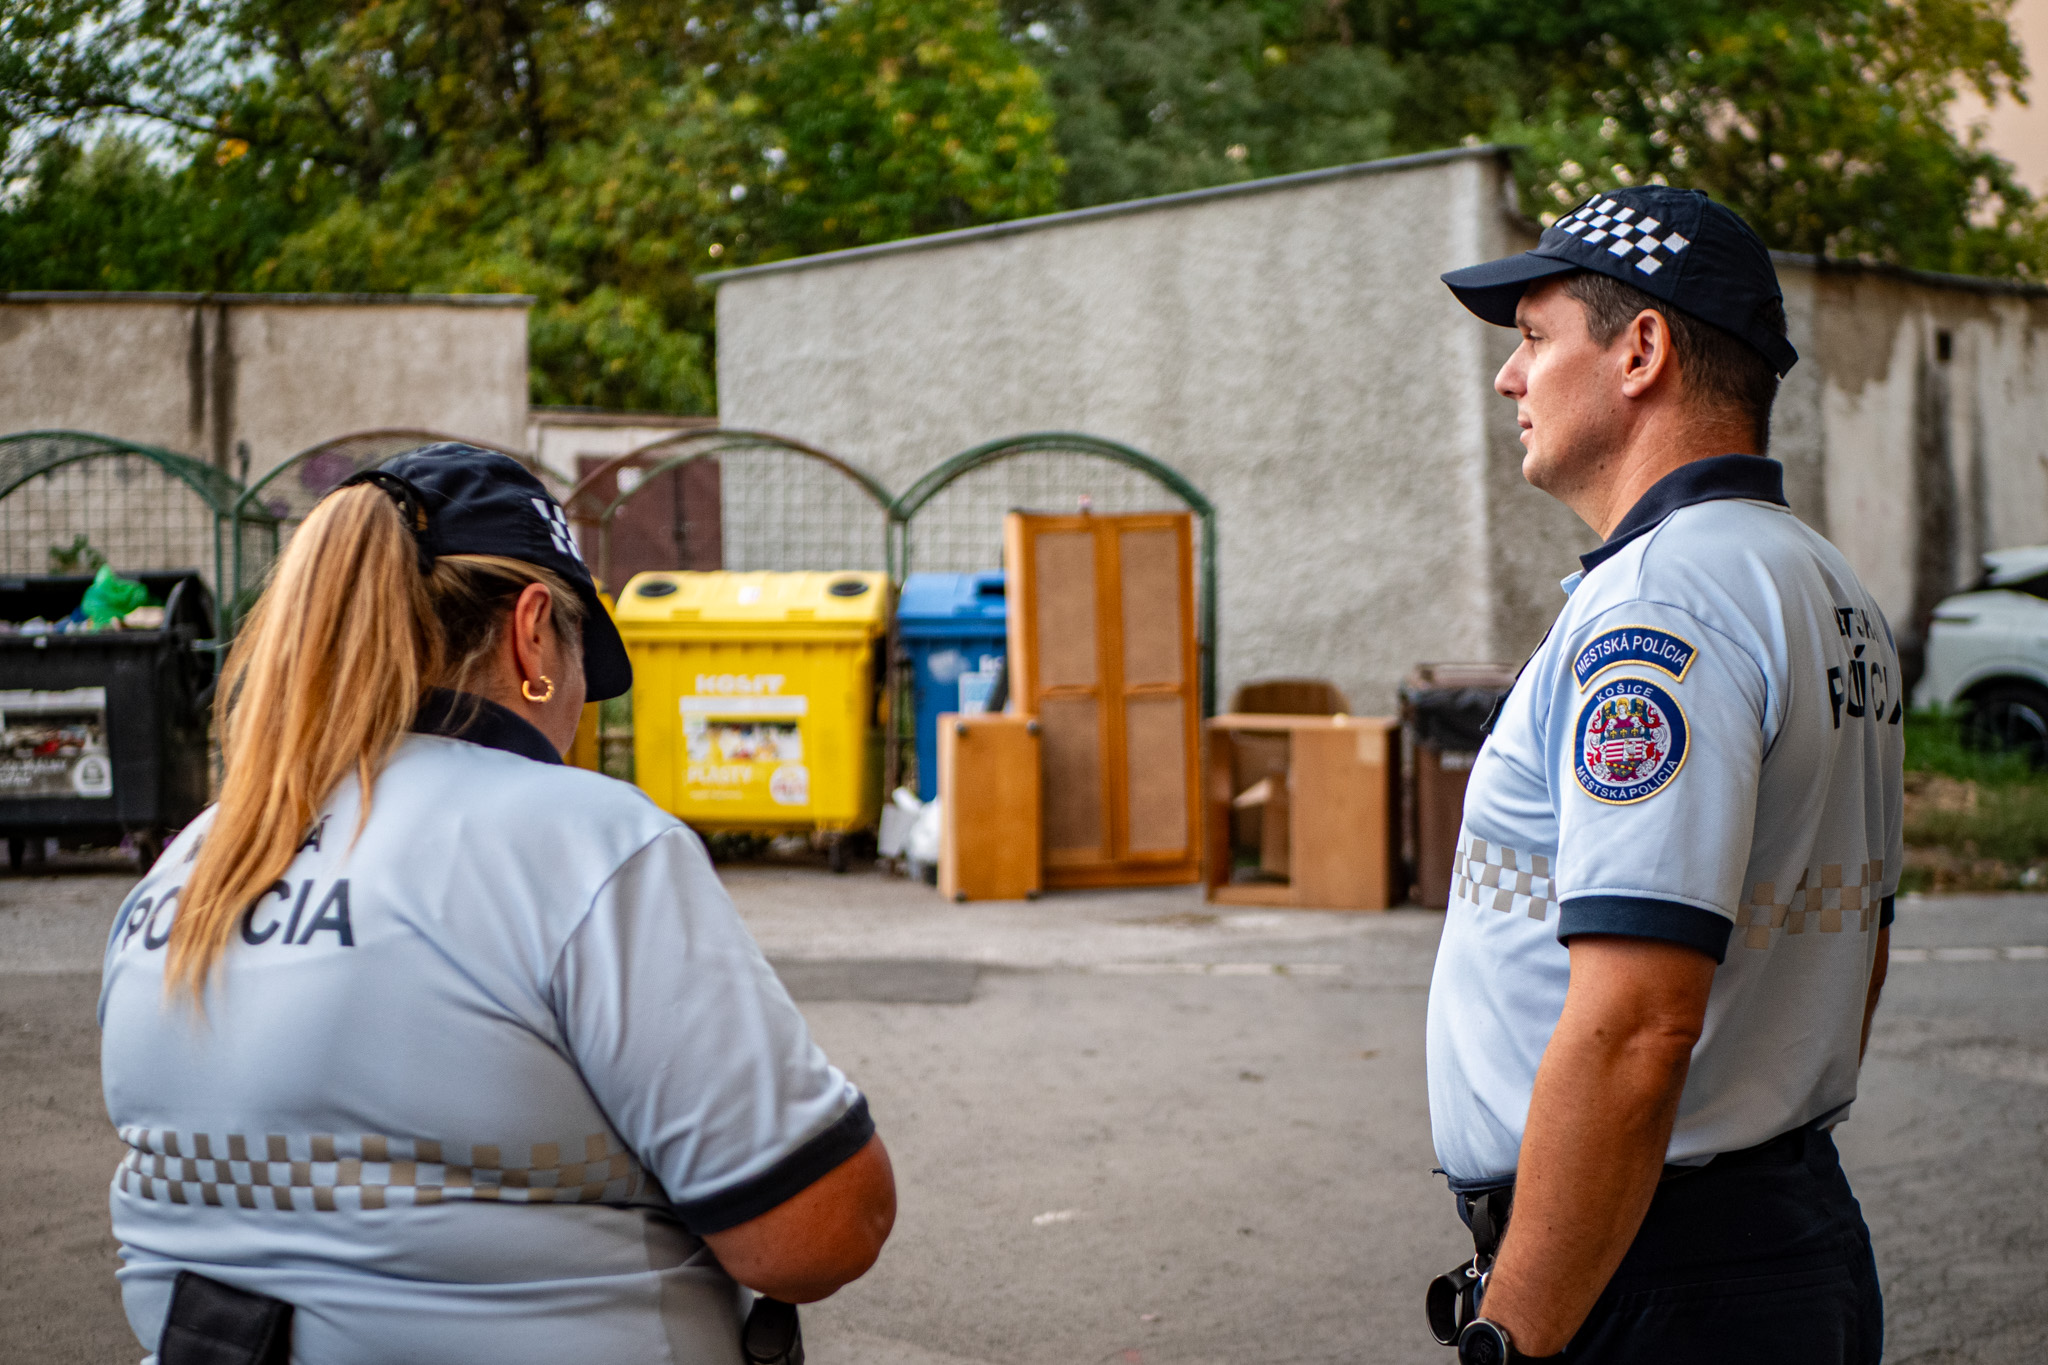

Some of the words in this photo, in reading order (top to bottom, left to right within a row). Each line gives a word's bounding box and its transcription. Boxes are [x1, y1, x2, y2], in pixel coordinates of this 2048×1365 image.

[1576, 633, 1630, 676] MESTSKÁ
[1632, 635, 1689, 668] POLÍCIA
[1595, 682, 1655, 703] KOŠICE
[121, 878, 356, 951] POCIA
